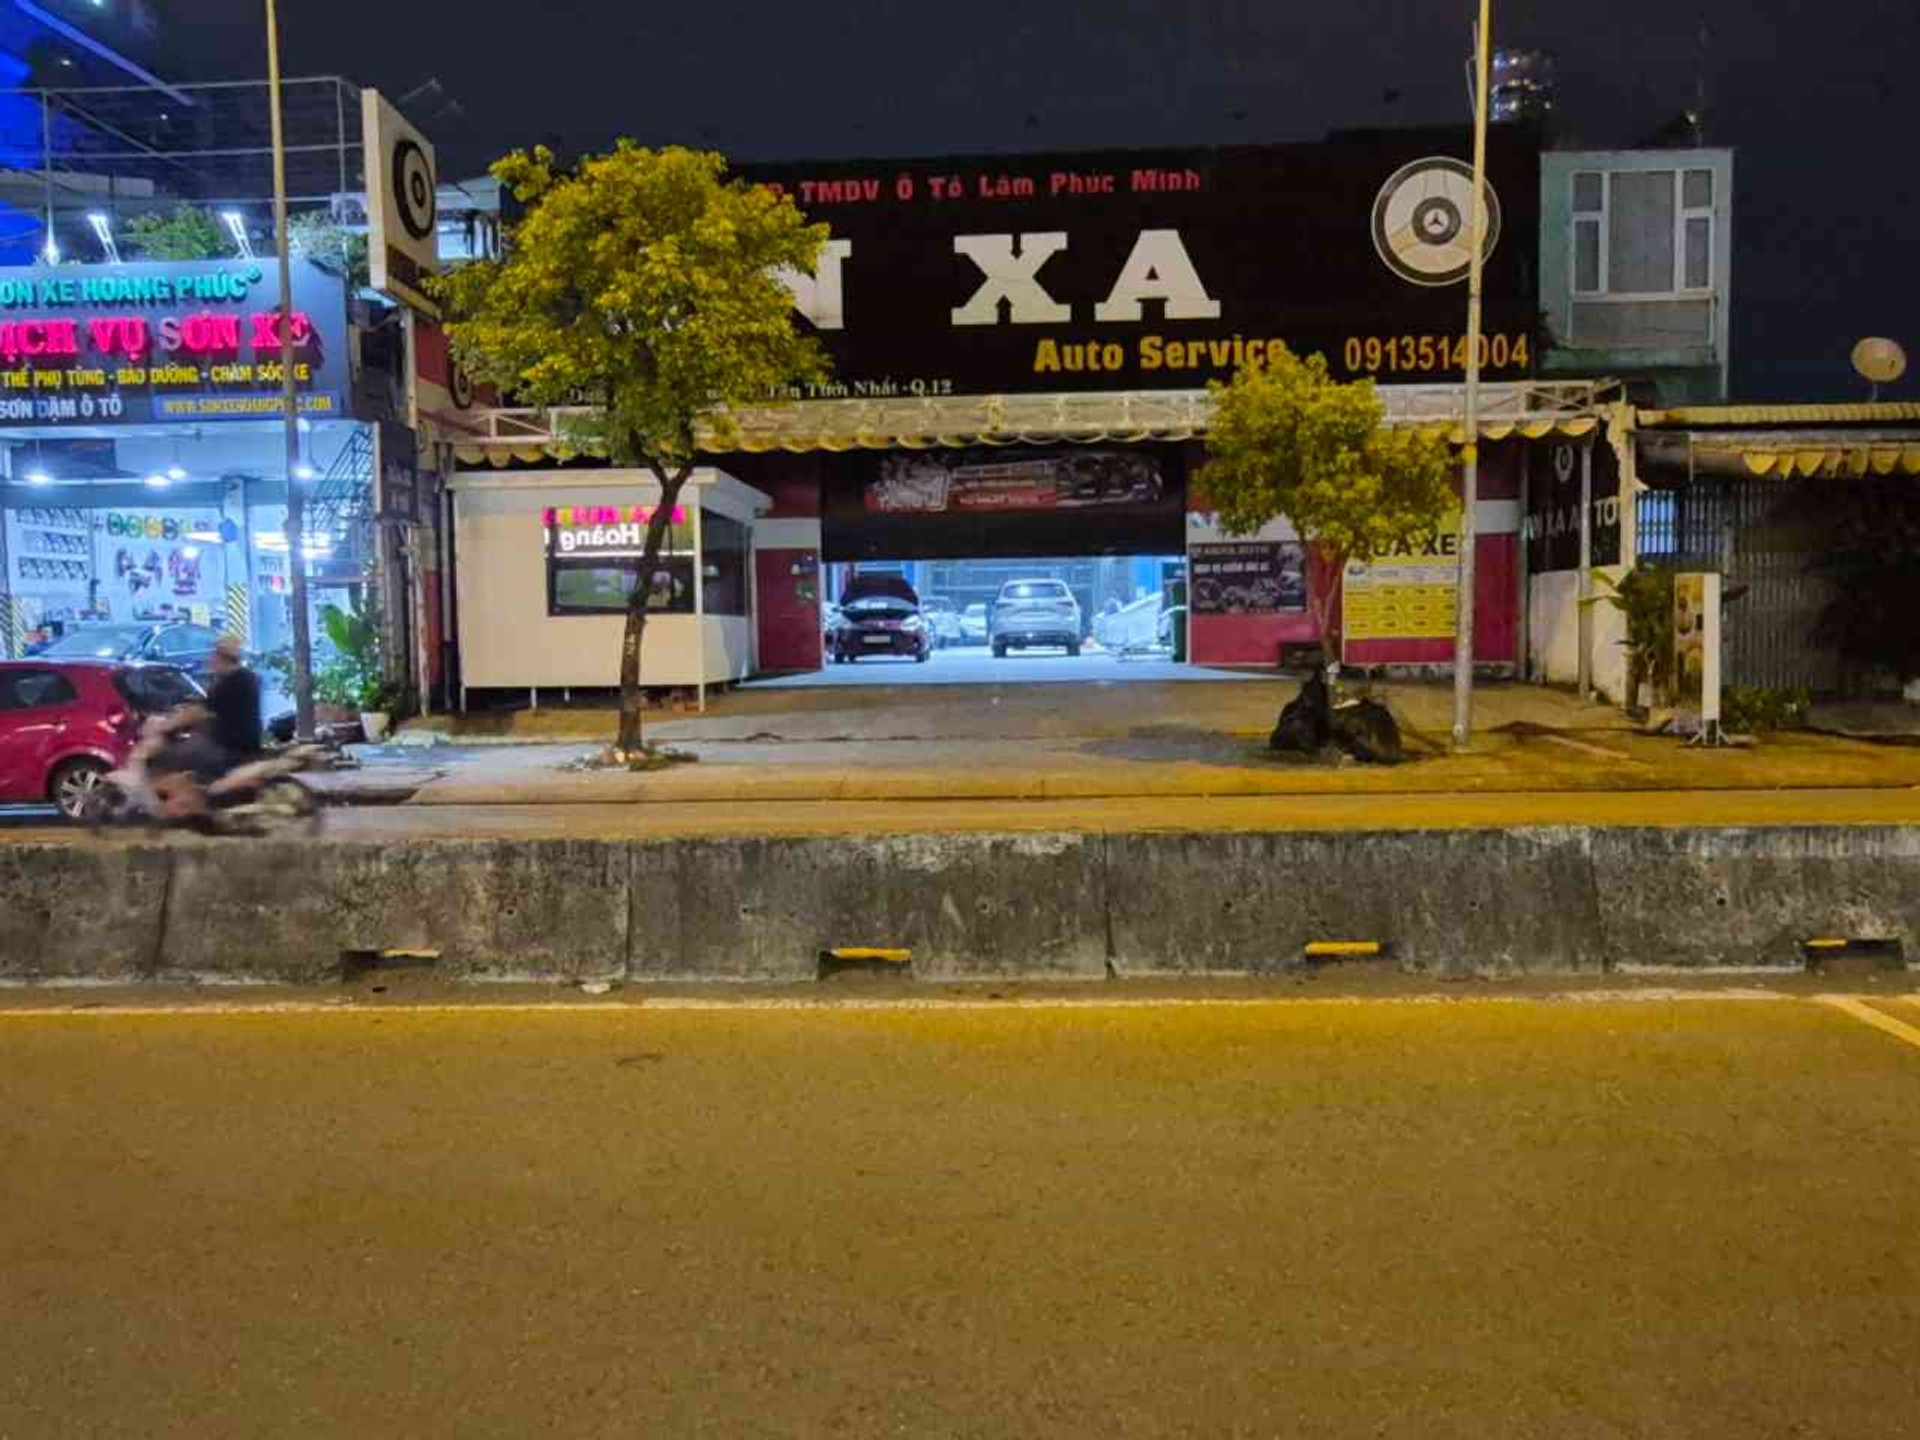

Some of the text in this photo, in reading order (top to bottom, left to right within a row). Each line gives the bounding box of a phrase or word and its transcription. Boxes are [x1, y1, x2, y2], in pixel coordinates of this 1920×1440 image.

[800, 179, 880, 203] TMDV
[1131, 167, 1201, 193] Minh
[42, 278, 75, 302] XE
[175, 267, 247, 298] PHÚC
[1034, 336, 1123, 373] Auto
[1344, 333, 1530, 371] 0913514004
[98, 392, 122, 416] TÔ
